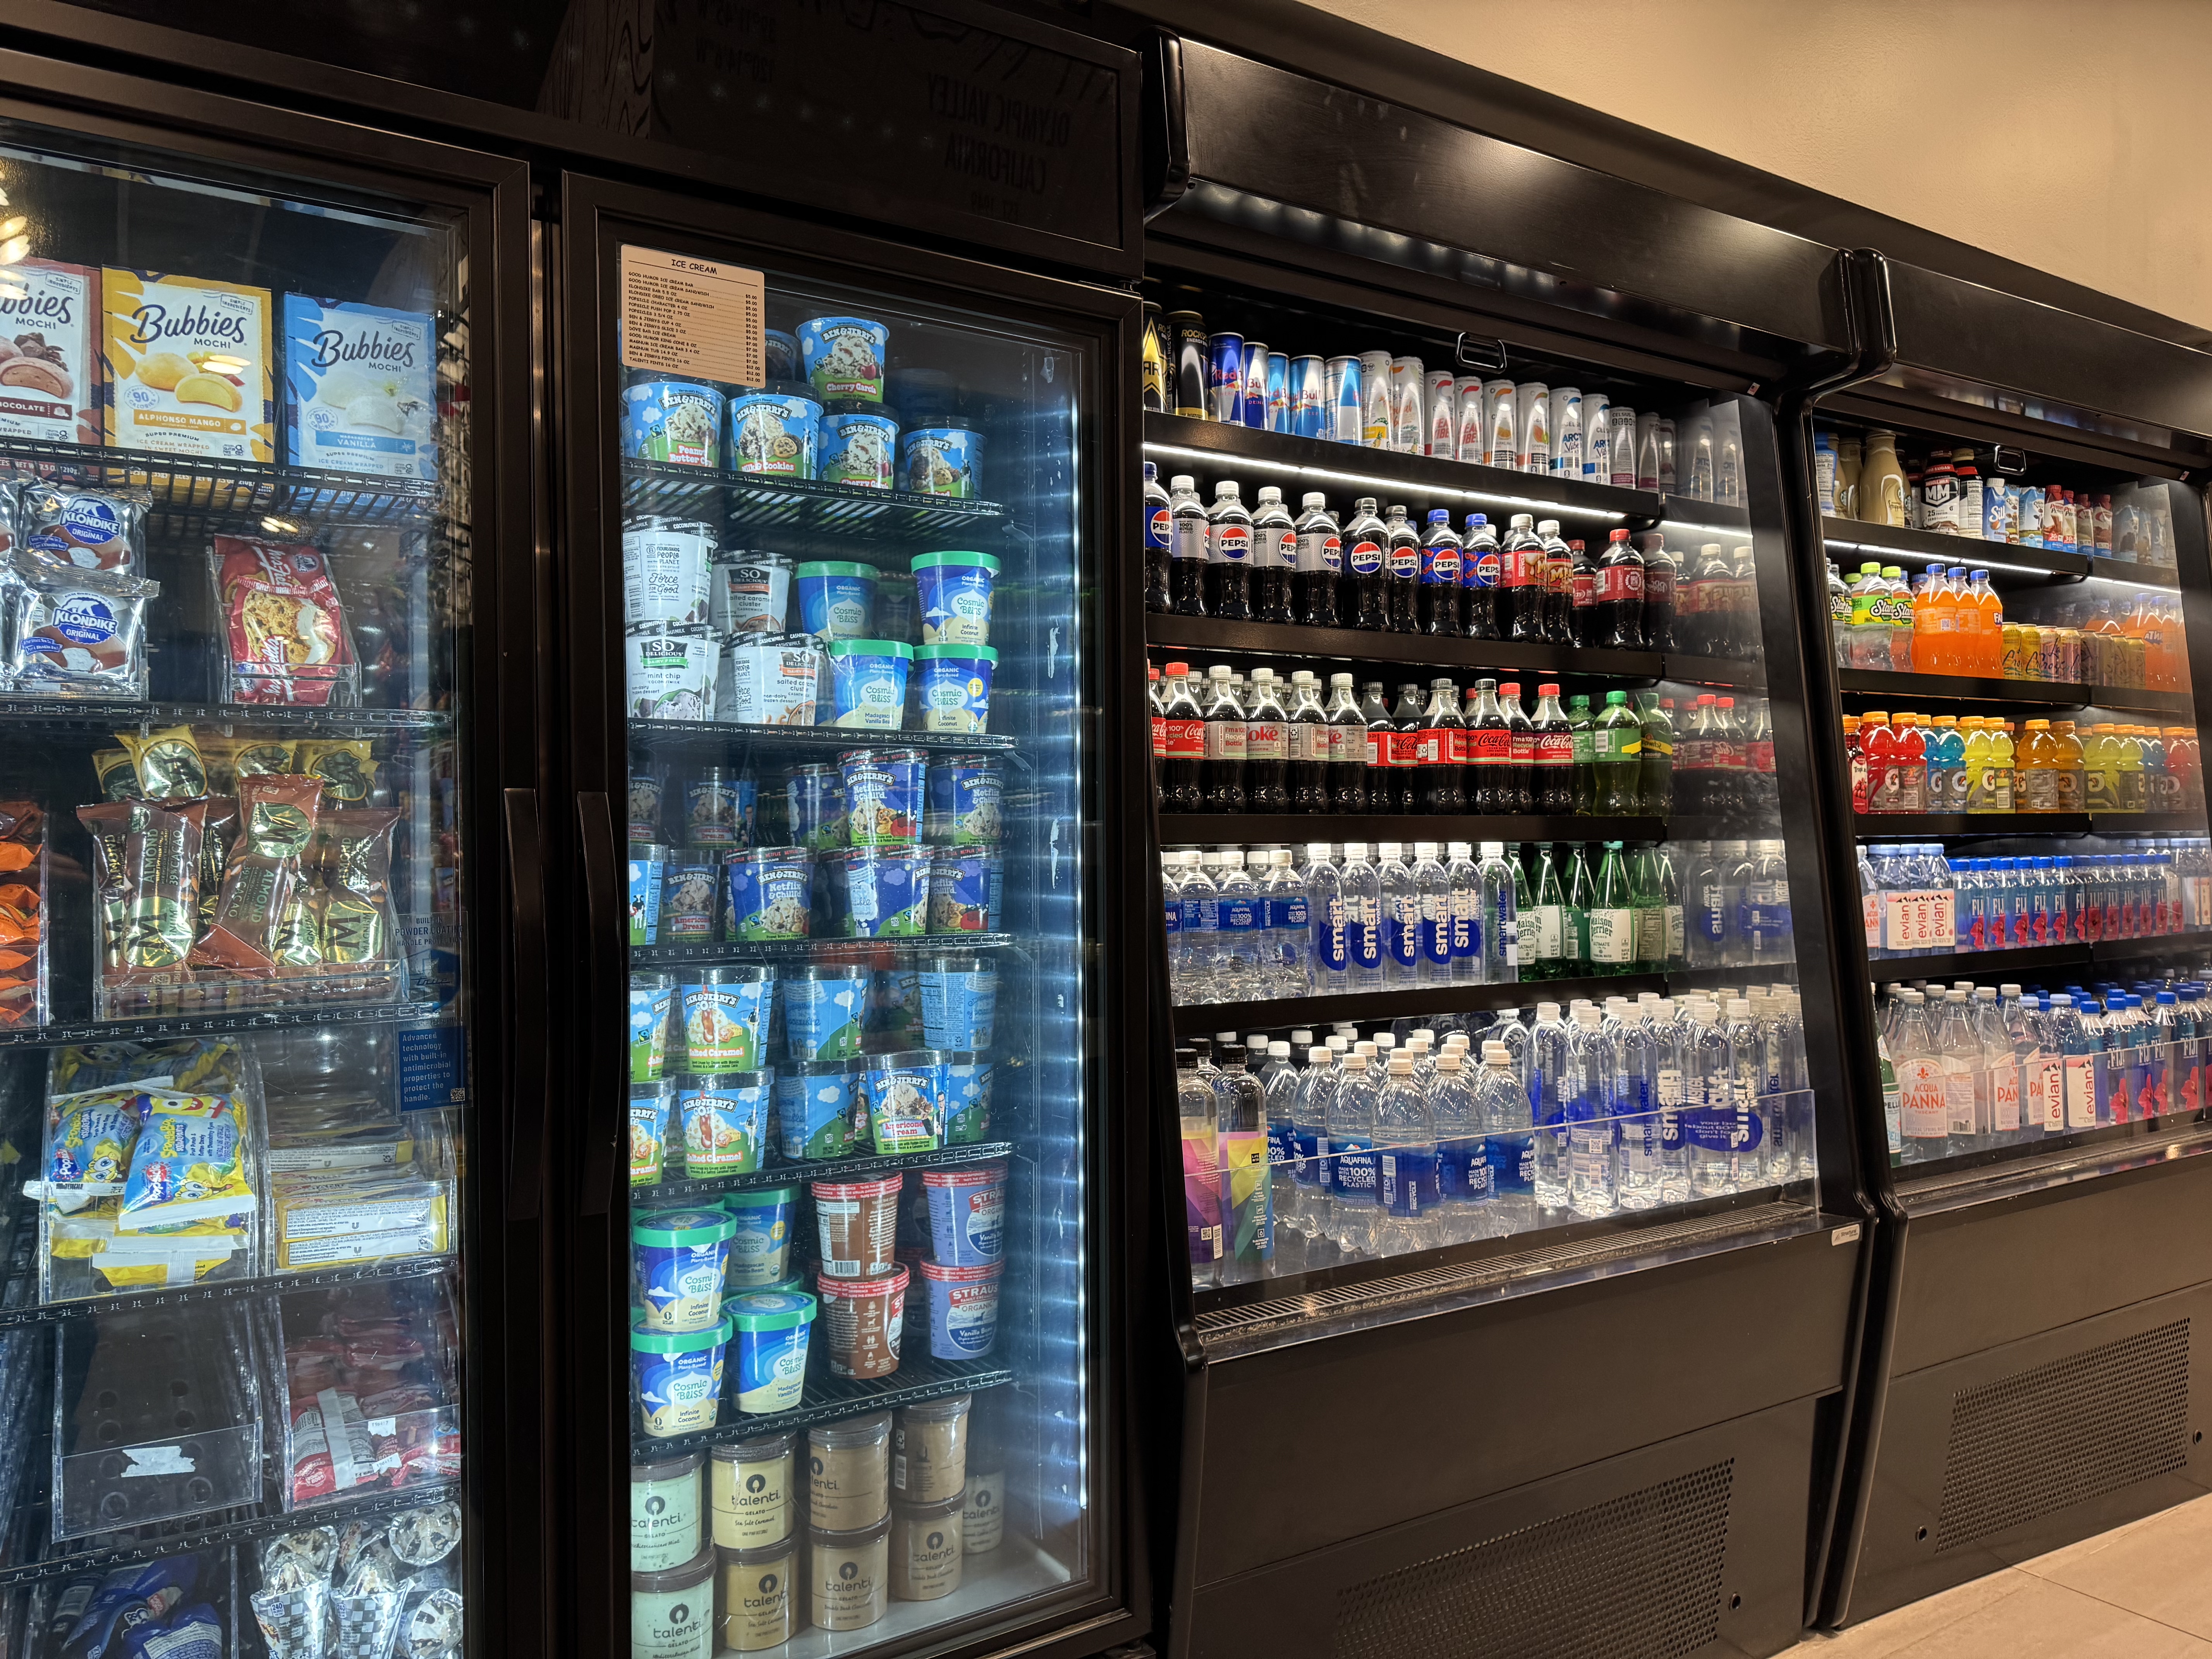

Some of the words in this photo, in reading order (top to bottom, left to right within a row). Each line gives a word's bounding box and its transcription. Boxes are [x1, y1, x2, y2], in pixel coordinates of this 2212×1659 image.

[672, 259, 686, 269] ICE
[689, 262, 717, 275] CREAM
[15, 317, 56, 329] MOCHI
[130, 304, 247, 343] Bubbies
[194, 338, 230, 349] MOCHI
[311, 330, 415, 368] Bubbies
[368, 362, 401, 373] MOCHI
[1215, 369, 1237, 380] Red
[827, 382, 852, 393] Cherry
[854, 384, 876, 395] Garcia
[1247, 378, 1266, 389] Bull
[133, 392, 149, 402] 90
[138, 413, 186, 424] ALPHONSO
[189, 418, 221, 427] MANGO
[337, 439, 376, 448] VANILLA
[1458, 433, 1477, 445] VIBE
[670, 454, 698, 463] Butter
[1989, 506, 2005, 522] Silk
[62, 510, 119, 533] KLONDIKE
[72, 529, 104, 541] ORIGINAL
[1221, 539, 1249, 548] PEPSI
[1352, 553, 1381, 563] PEPSI
[649, 572, 678, 584] Force
[657, 583, 679, 594] Good
[652, 641, 674, 651] SO
[143, 829, 158, 883] ALMOND
[769, 881, 801, 891] Netflix
[1499, 889, 1507, 957] smartwater
[1936, 902, 1944, 937] evian
[1332, 897, 1344, 962] smart
[403, 1032, 437, 1041] Advanced
[403, 1042, 441, 1052] technology
[708, 1048, 744, 1057] Caramel
[2183, 1039, 2198, 1056] FIJI
[421, 1052, 447, 1061] built-in
[404, 1061, 451, 1072] antimicrobial
[404, 1073, 441, 1082] properties
[404, 1084, 430, 1093] protect
[1914, 1084, 1938, 1093] ACQUA
[404, 1094, 430, 1102] handle.
[1903, 1092, 1945, 1109] PANNA
[2051, 1073, 2061, 1119] evian
[1340, 1156, 1372, 1165] AQUAFINA
[1350, 1167, 1376, 1176] 100%
[953, 1285, 998, 1300] STRAUS
[678, 1356, 707, 1365] ORGANIC
[674, 1379, 707, 1391] Cosmic
[732, 1490, 779, 1506] talenti
[755, 1516, 775, 1525] Caramel
[826, 1577, 872, 1592] talenti
[653, 1620, 701, 1639] talenti
